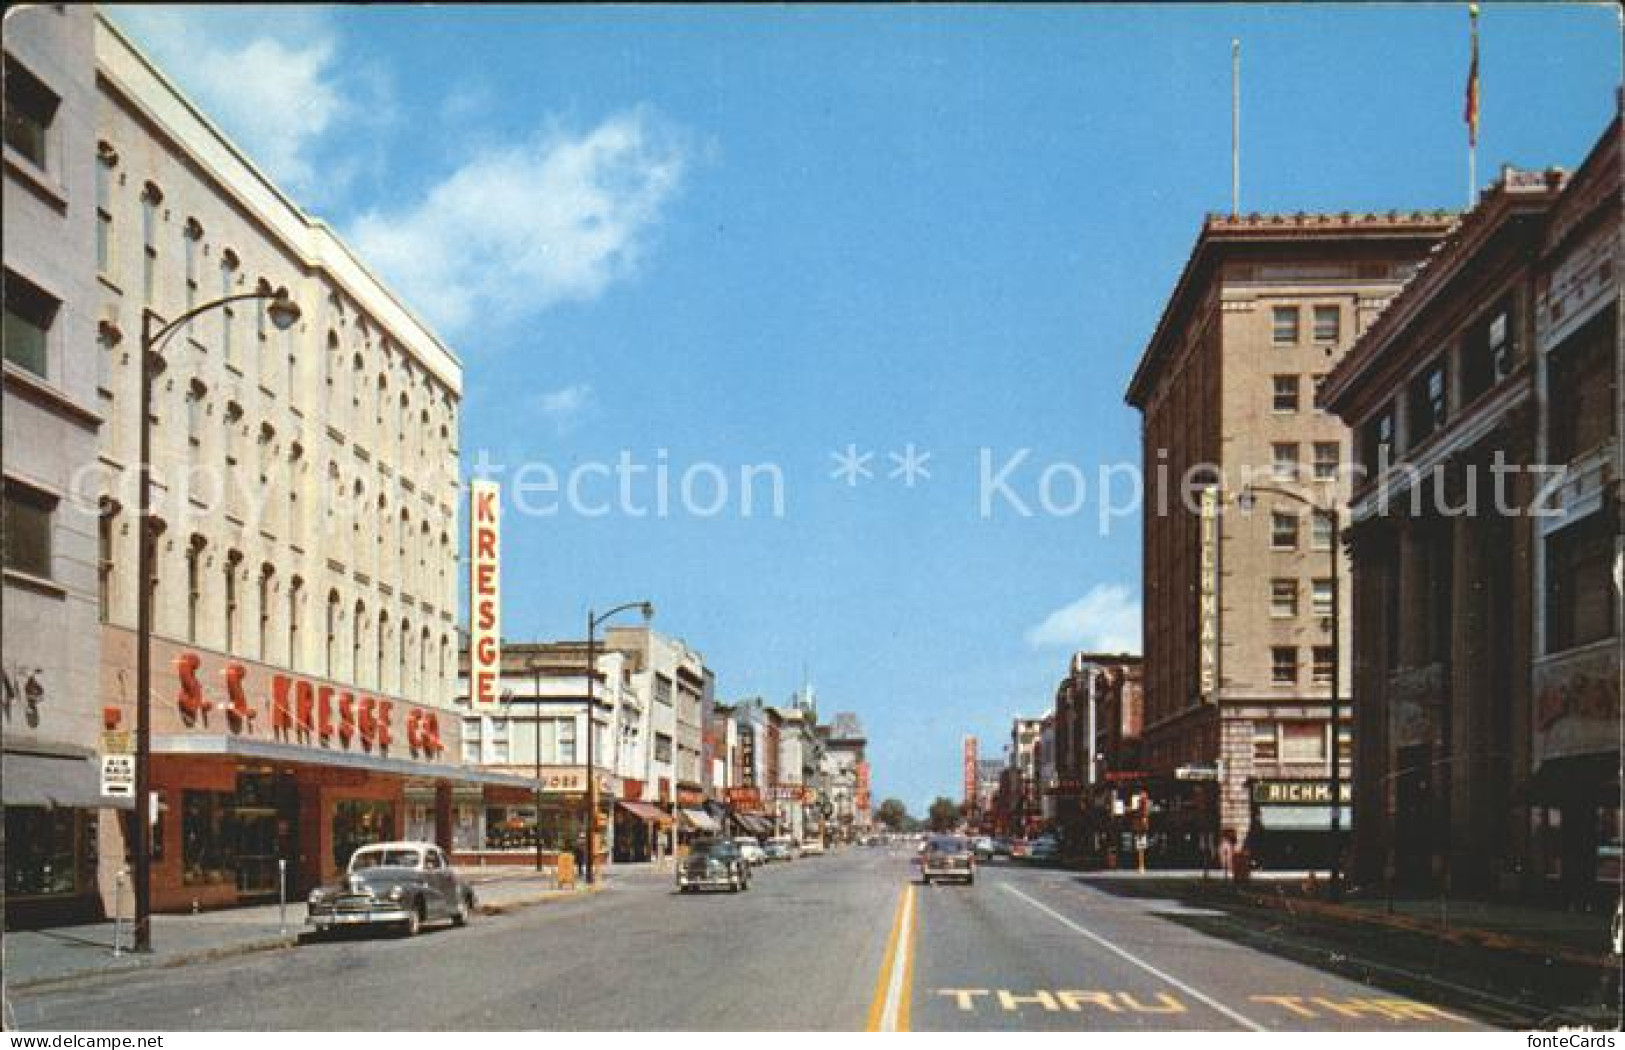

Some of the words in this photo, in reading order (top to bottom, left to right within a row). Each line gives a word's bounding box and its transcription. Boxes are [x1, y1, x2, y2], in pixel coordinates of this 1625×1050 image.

[478, 492, 496, 703] KRESGE
[178, 652, 212, 712] S.
[226, 664, 257, 719] S.
[272, 674, 393, 745] KRESGE
[1267, 785, 1352, 800] RICHMN
[936, 989, 1188, 1012] THRU
